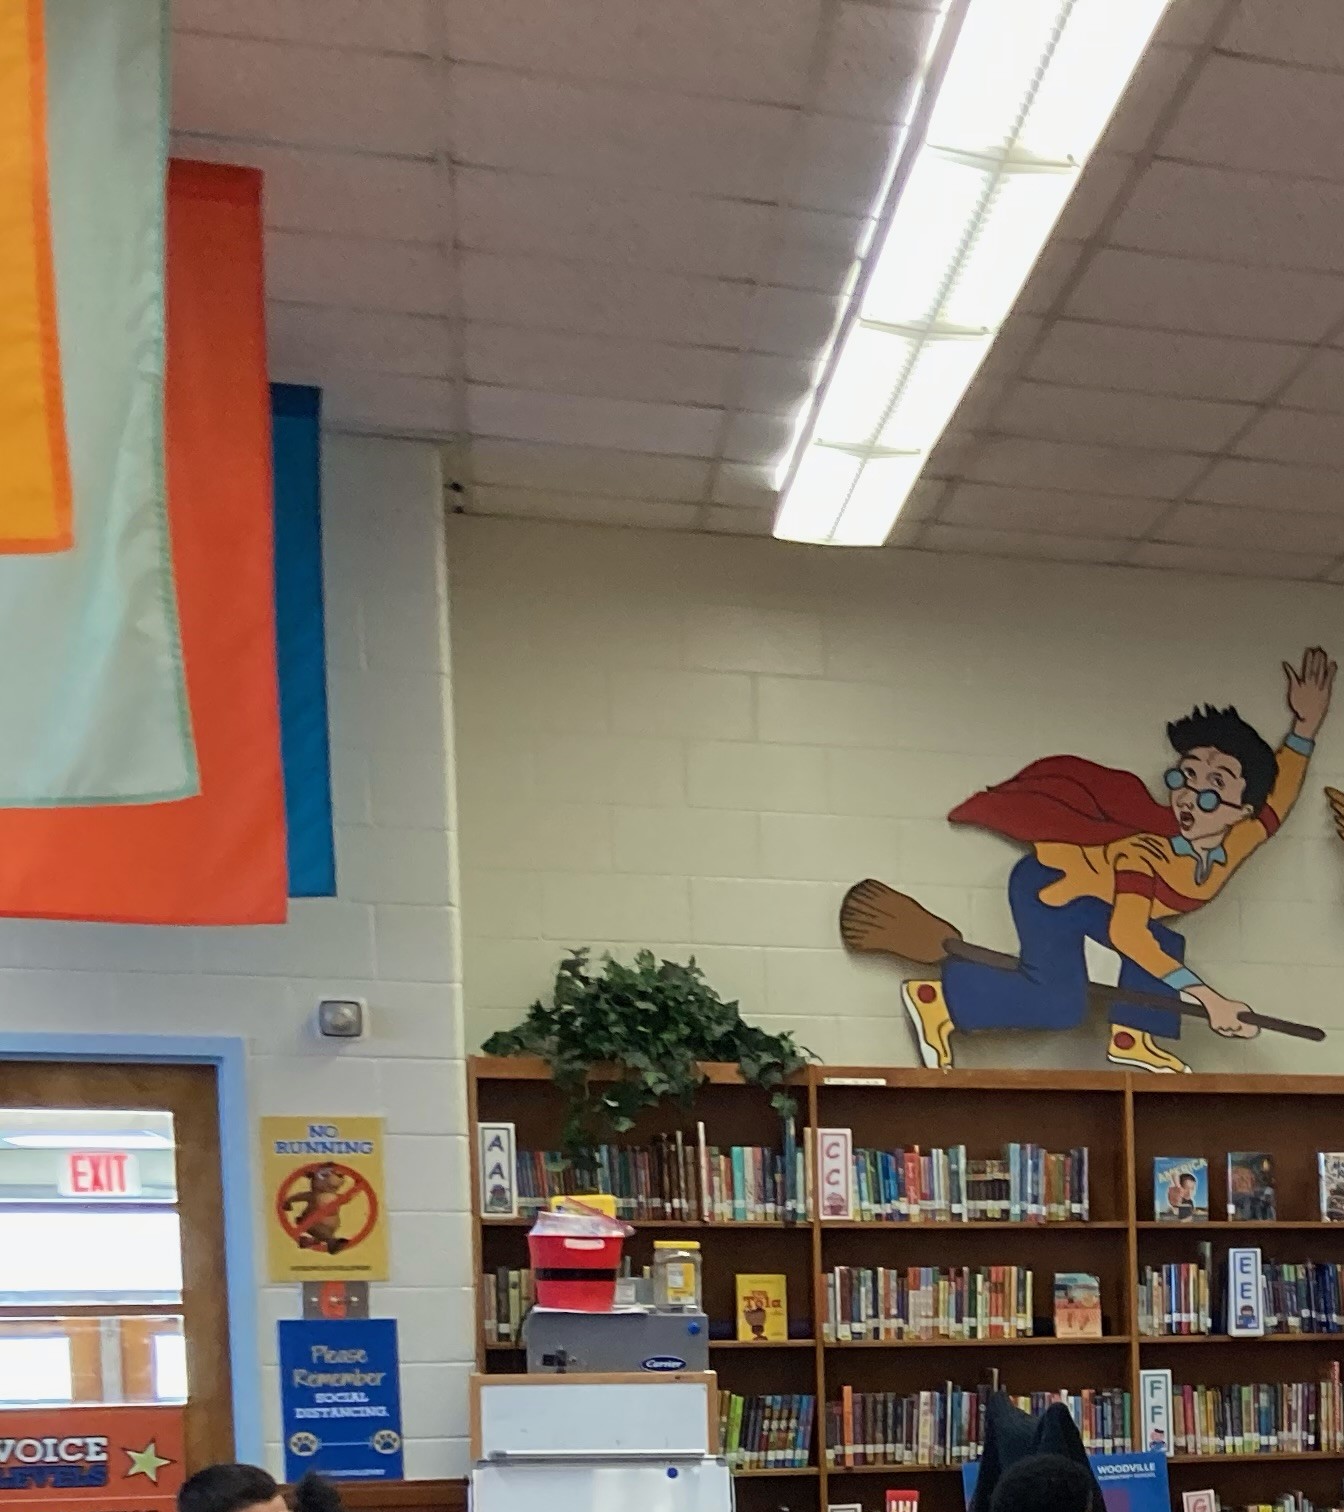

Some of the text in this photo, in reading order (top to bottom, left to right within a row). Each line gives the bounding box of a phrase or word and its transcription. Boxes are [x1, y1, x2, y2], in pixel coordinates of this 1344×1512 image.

[308, 1125, 338, 1138] NO
[275, 1141, 373, 1154] RUNNING
[69, 1153, 128, 1192] EXIT
[311, 1345, 368, 1364] Please
[293, 1368, 386, 1388] Remember
[315, 1392, 370, 1403] SOCIAL
[1096, 1462, 1155, 1474] WOODVILLE
